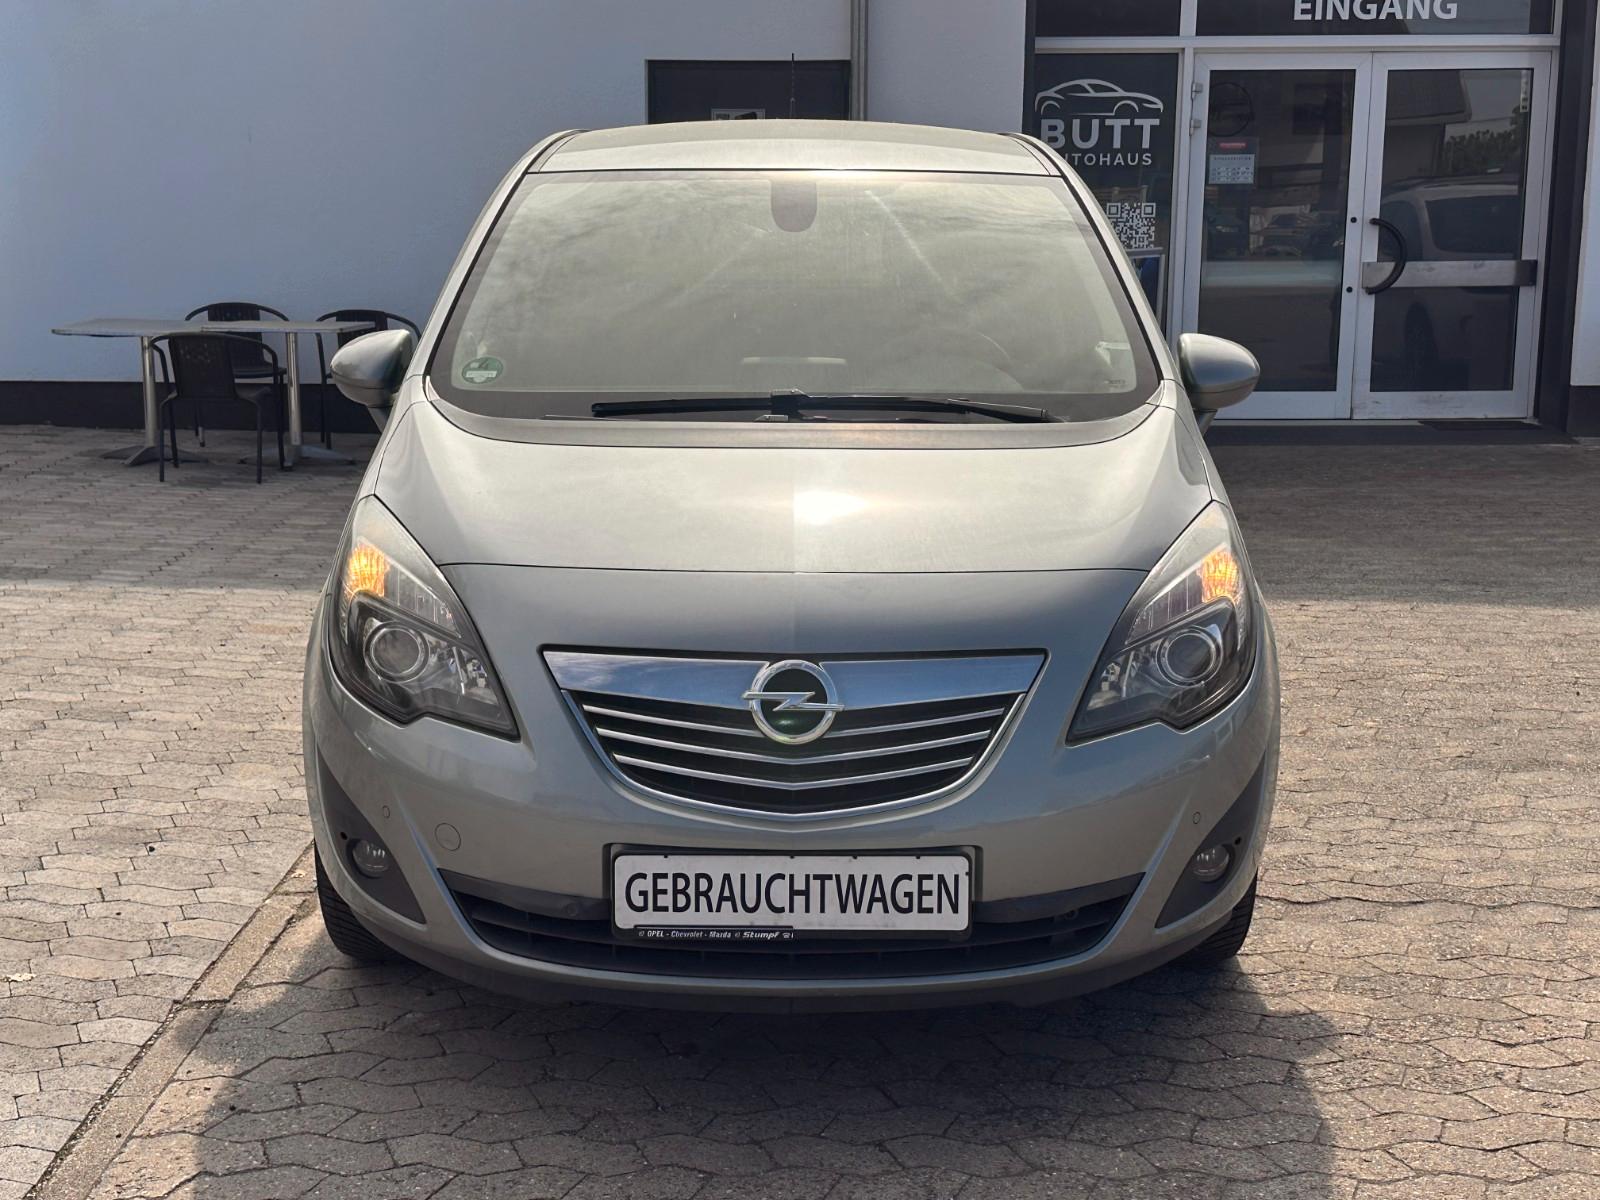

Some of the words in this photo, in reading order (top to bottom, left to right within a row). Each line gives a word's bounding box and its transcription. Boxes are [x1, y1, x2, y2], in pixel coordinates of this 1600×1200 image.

[1293, 0, 1458, 21] EINGANG
[1040, 118, 1160, 150] BUTT
[1063, 152, 1153, 166] TOHAUS
[624, 872, 960, 915] GEBRAUCHTWAGEN
[647, 930, 665, 938] OPEL
[670, 930, 703, 939] Chevrolet
[742, 930, 780, 940] Stumpf
